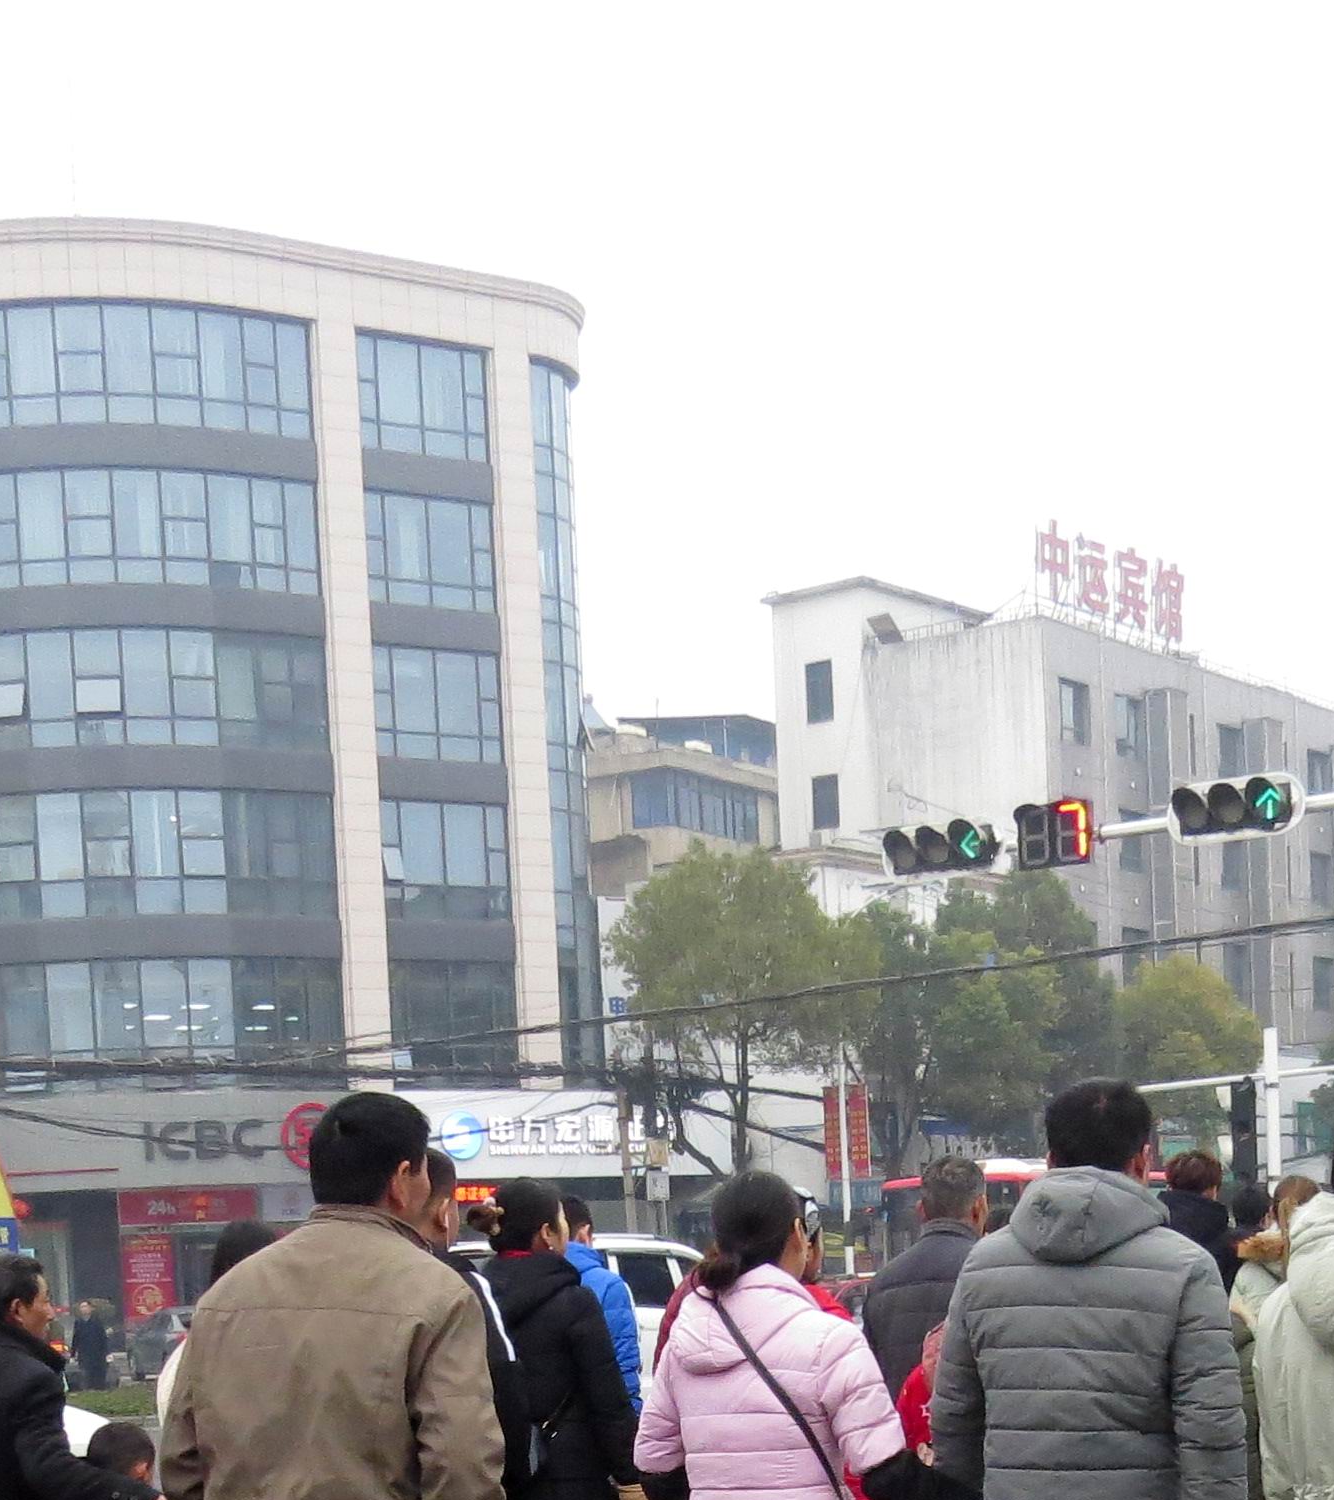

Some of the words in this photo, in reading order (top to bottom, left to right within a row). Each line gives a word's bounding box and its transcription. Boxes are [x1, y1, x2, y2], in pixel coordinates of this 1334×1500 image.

[1035, 518, 1185, 643] 中运宾馆
[1058, 801, 1088, 857] 7
[142, 1118, 266, 1162] ICBC
